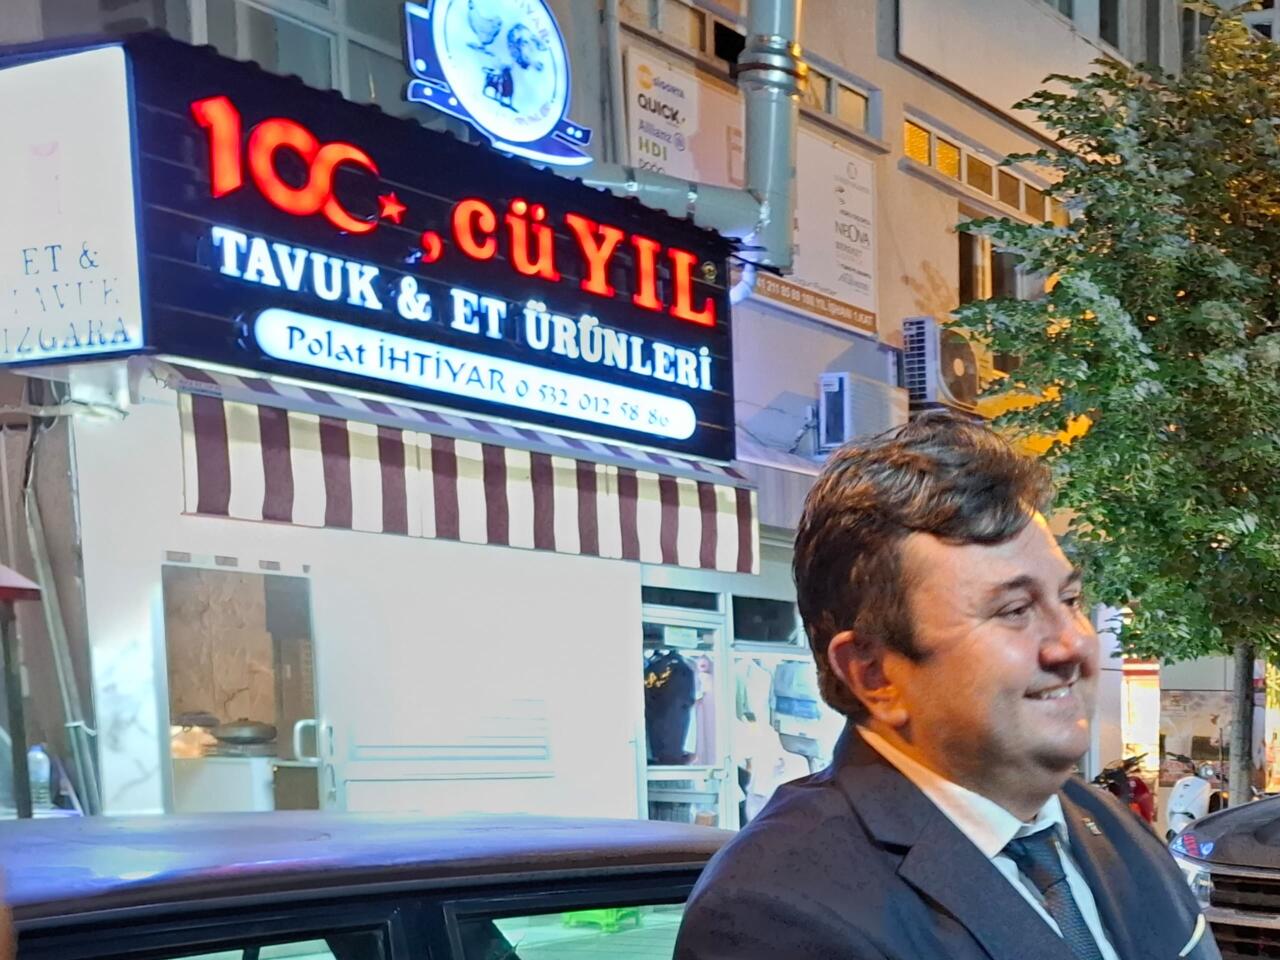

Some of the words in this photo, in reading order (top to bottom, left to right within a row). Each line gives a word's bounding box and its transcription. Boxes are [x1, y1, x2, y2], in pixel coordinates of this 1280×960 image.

[639, 136, 668, 161] HDI
[22, 245, 62, 275] ET
[79, 241, 99, 269] &
[564, 212, 717, 328] YIL
[211, 226, 384, 311] TAVUK
[396, 275, 432, 322] &
[450, 287, 507, 341] ET
[523, 299, 713, 391] ÜRÜNLERİ
[286, 326, 365, 365] Polat
[379, 338, 506, 394] İHTİYAR
[515, 379, 529, 398] 0
[538, 384, 568, 406] 532
[579, 393, 610, 414] 012
